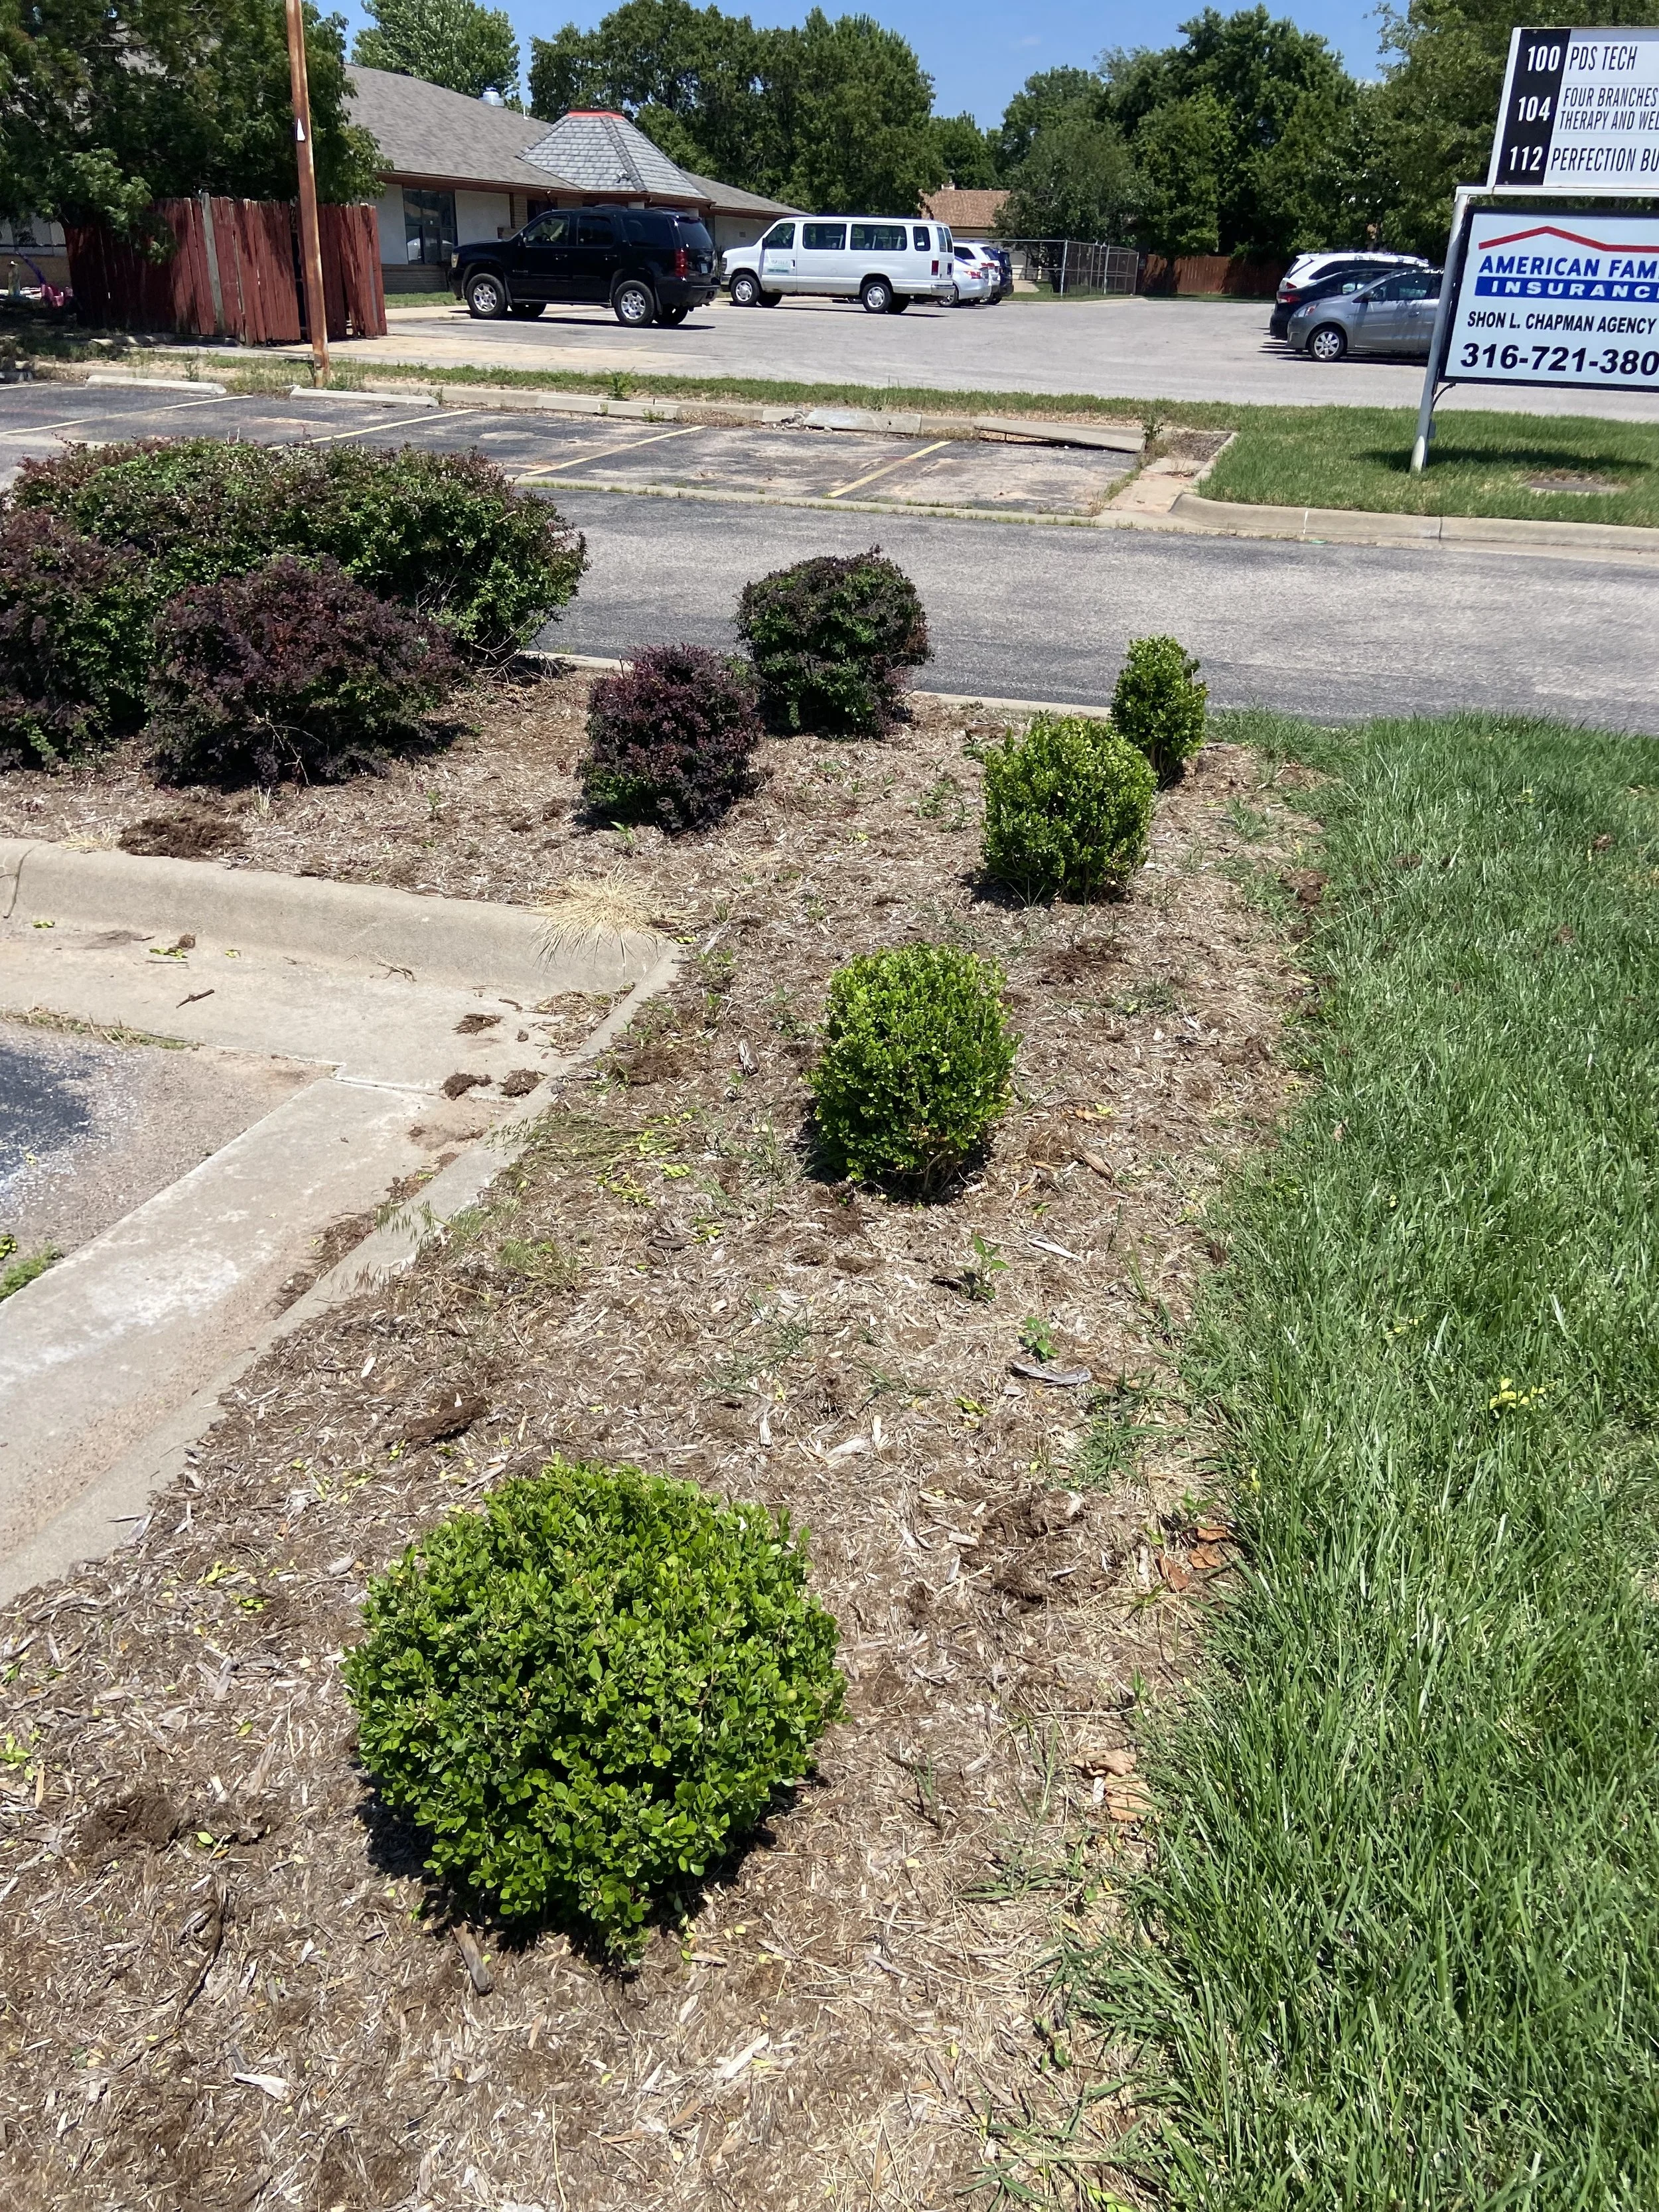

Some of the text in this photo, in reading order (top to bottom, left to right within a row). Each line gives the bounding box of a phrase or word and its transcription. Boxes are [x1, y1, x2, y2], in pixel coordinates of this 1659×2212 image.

[1527, 46, 1637, 72] 100 PDS TECH
[1518, 96, 1550, 121] 104
[1563, 88, 1658, 107] FOUR BRANCHES
[1559, 111, 1609, 129] THERAPY
[1611, 111, 1634, 130] AND
[1510, 146, 1543, 171] 112
[1551, 148, 1636, 171] PERFECTION
[1479, 256, 1659, 279] AMERICAN FAM
[1491, 281, 1659, 298] INSURANC
[1467, 311, 1656, 334] SHON L. CHAPMAN AGENCY
